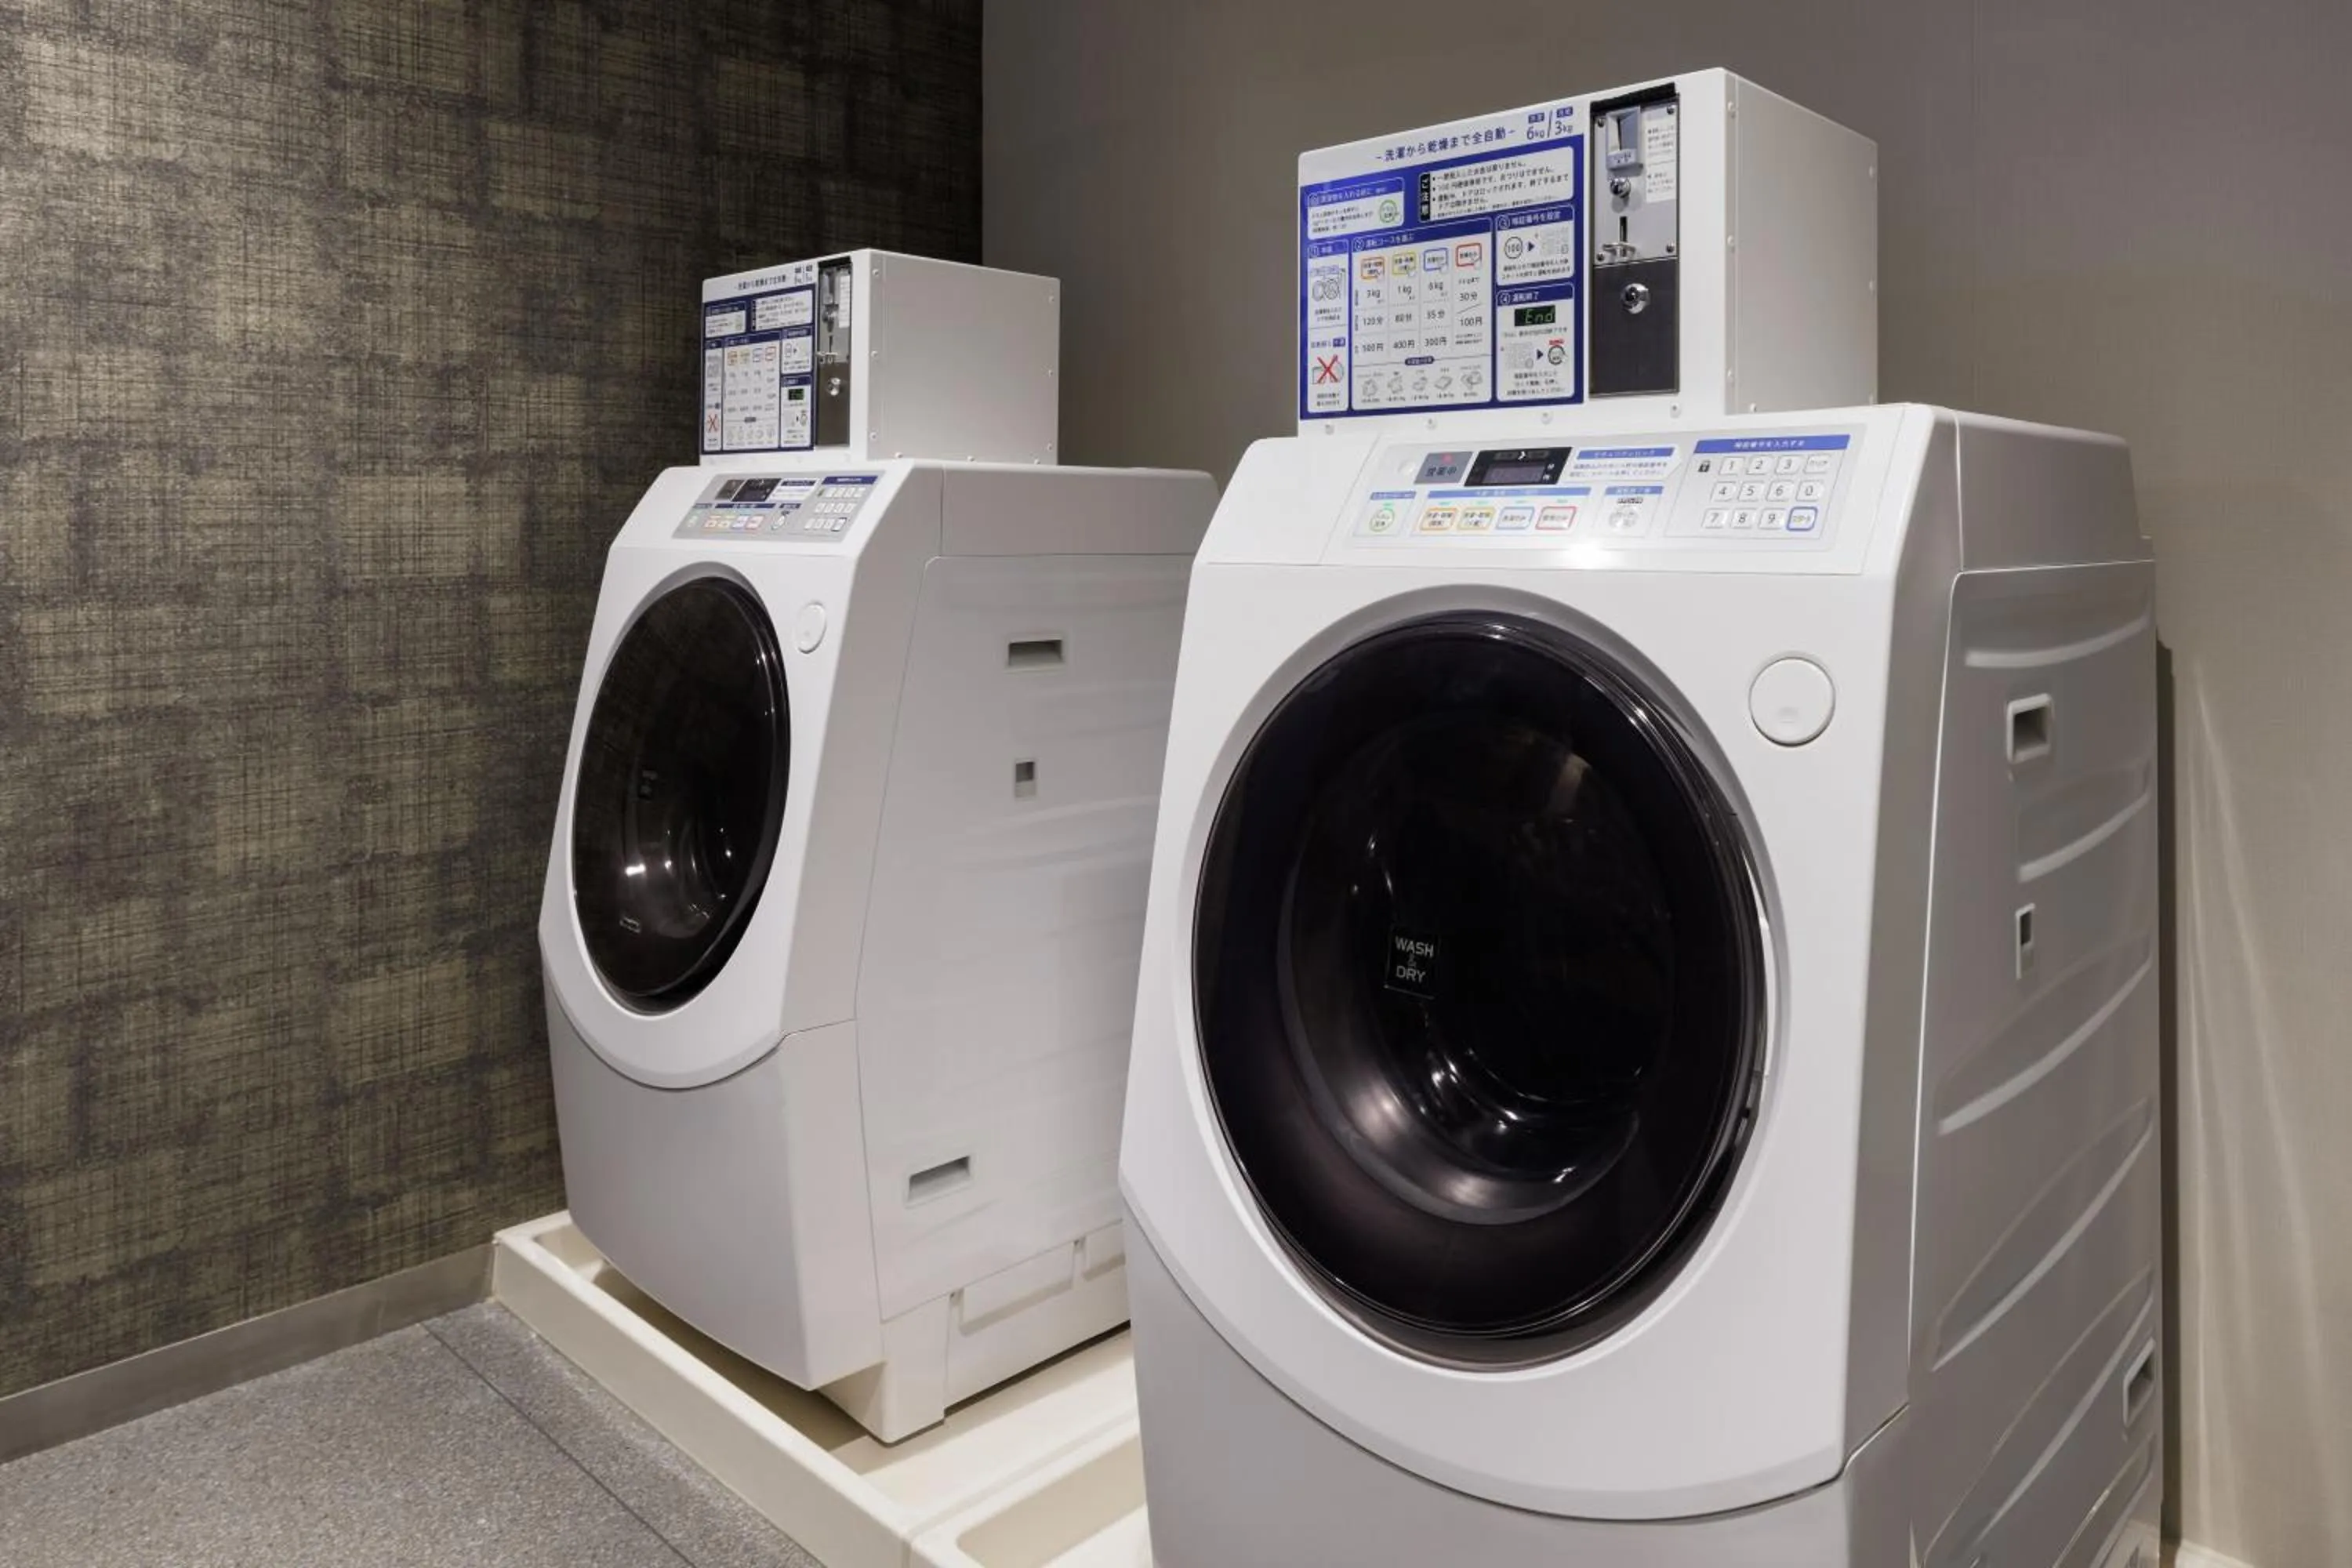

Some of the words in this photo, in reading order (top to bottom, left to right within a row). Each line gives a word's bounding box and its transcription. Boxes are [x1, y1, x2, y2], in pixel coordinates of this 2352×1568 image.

[1526, 125, 1544, 140] 6kg
[1555, 120, 1573, 135] 3kg
[1460, 316, 1483, 327] 100円
[1525, 307, 1553, 325] End
[1755, 460, 1763, 470] 2
[1784, 459, 1791, 470] 3
[1719, 486, 1727, 495] 4
[1747, 486, 1754, 496] 5
[1776, 485, 1784, 495] 6
[1805, 485, 1813, 495] 0
[1711, 512, 1719, 522] 7
[1738, 513, 1747, 523] 8
[1767, 513, 1776, 523] 9
[1395, 935, 1434, 958] WASH
[1396, 965, 1426, 984] DRY
